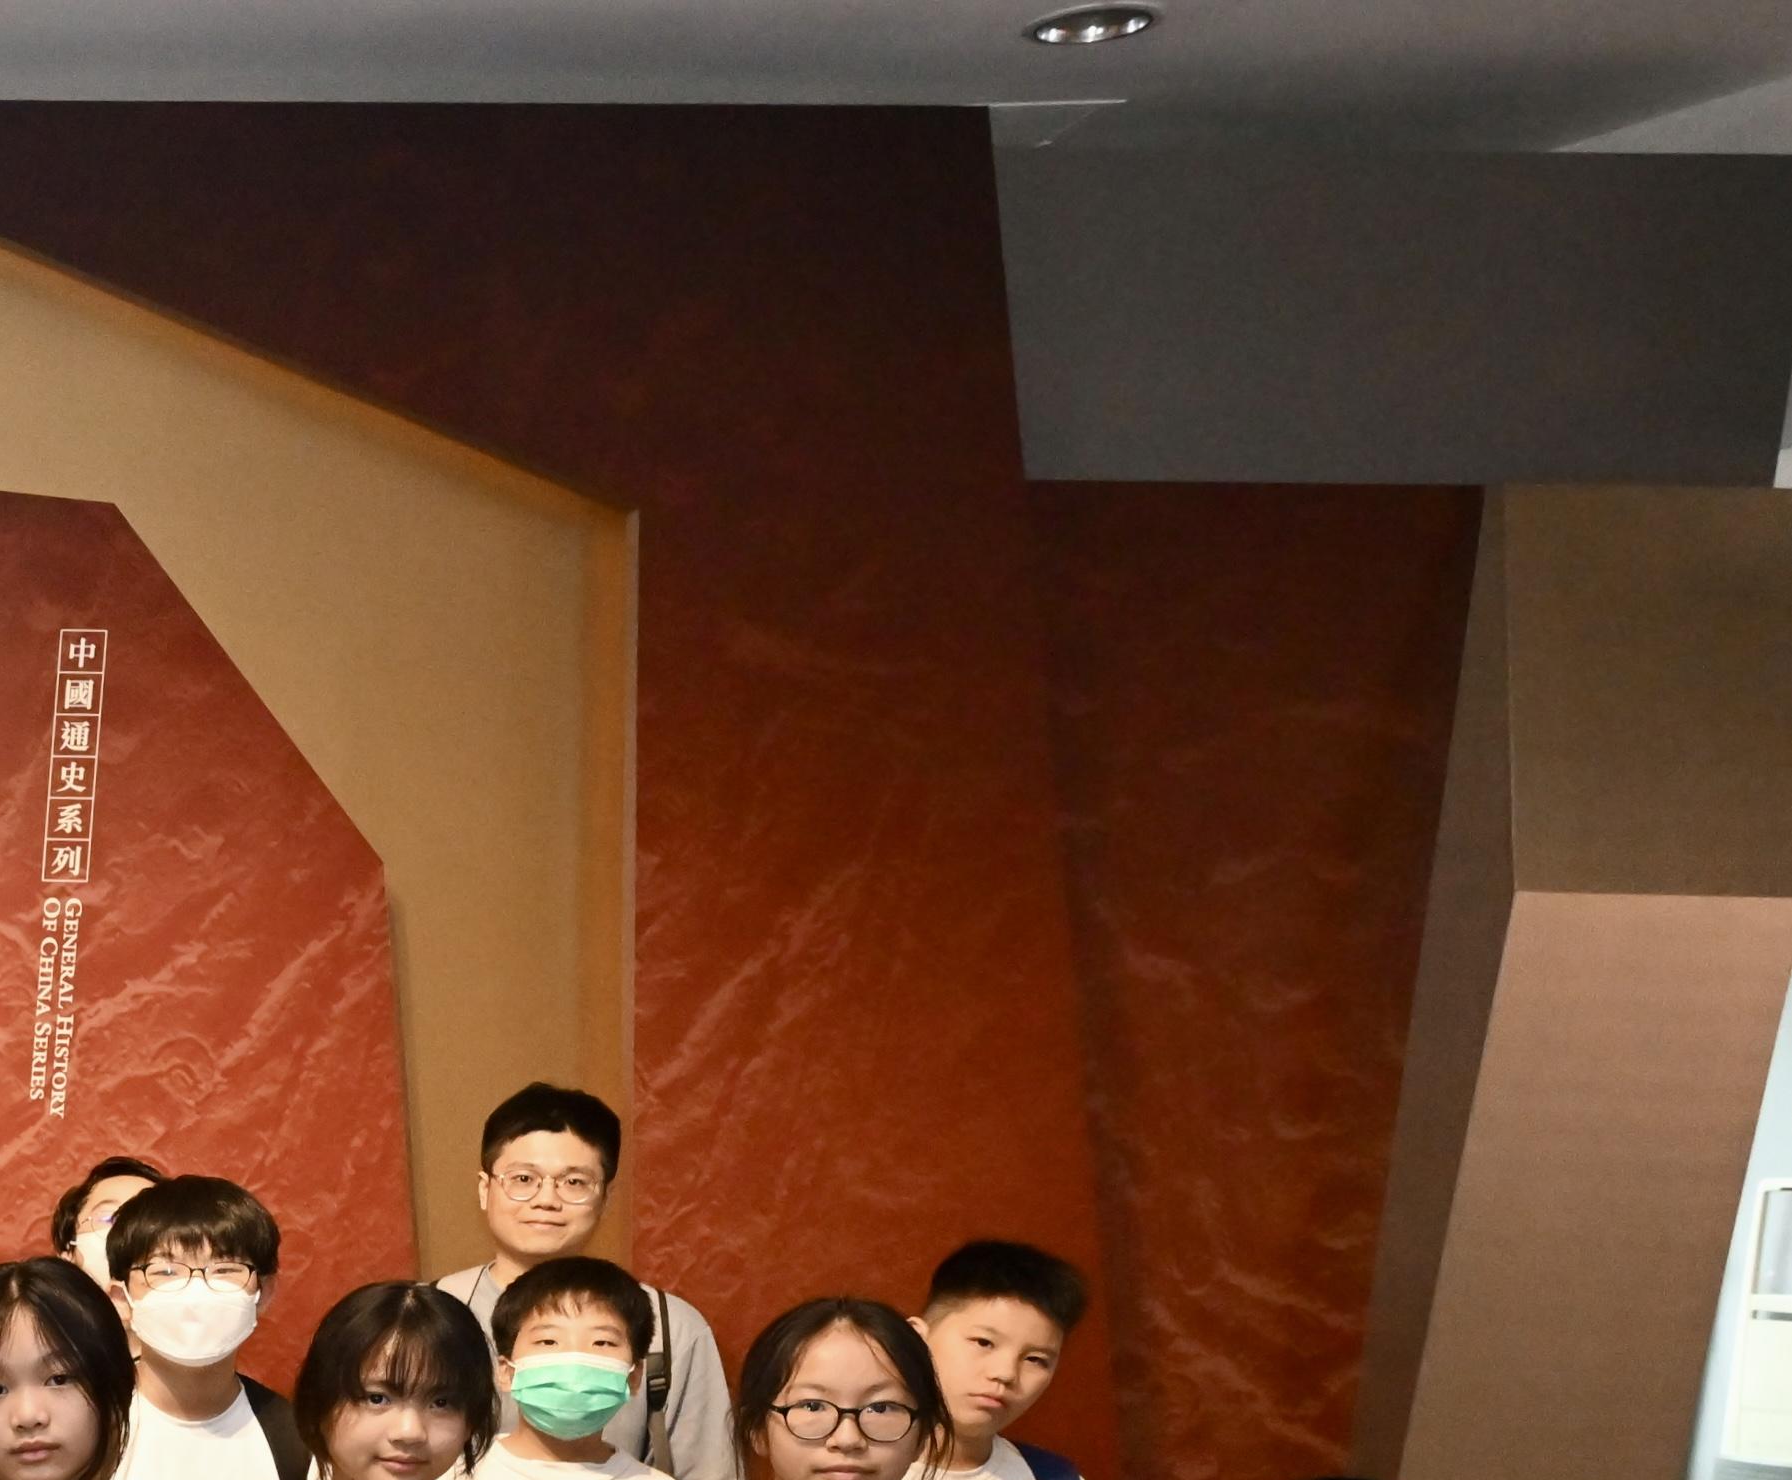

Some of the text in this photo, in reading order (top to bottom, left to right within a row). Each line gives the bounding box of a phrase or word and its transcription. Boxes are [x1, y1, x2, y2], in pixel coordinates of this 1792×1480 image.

[50, 636, 97, 877] 中國通史系列
[29, 896, 61, 1101] OF CHINA SERIES
[49, 897, 83, 1120] GENERAL HISTORY
